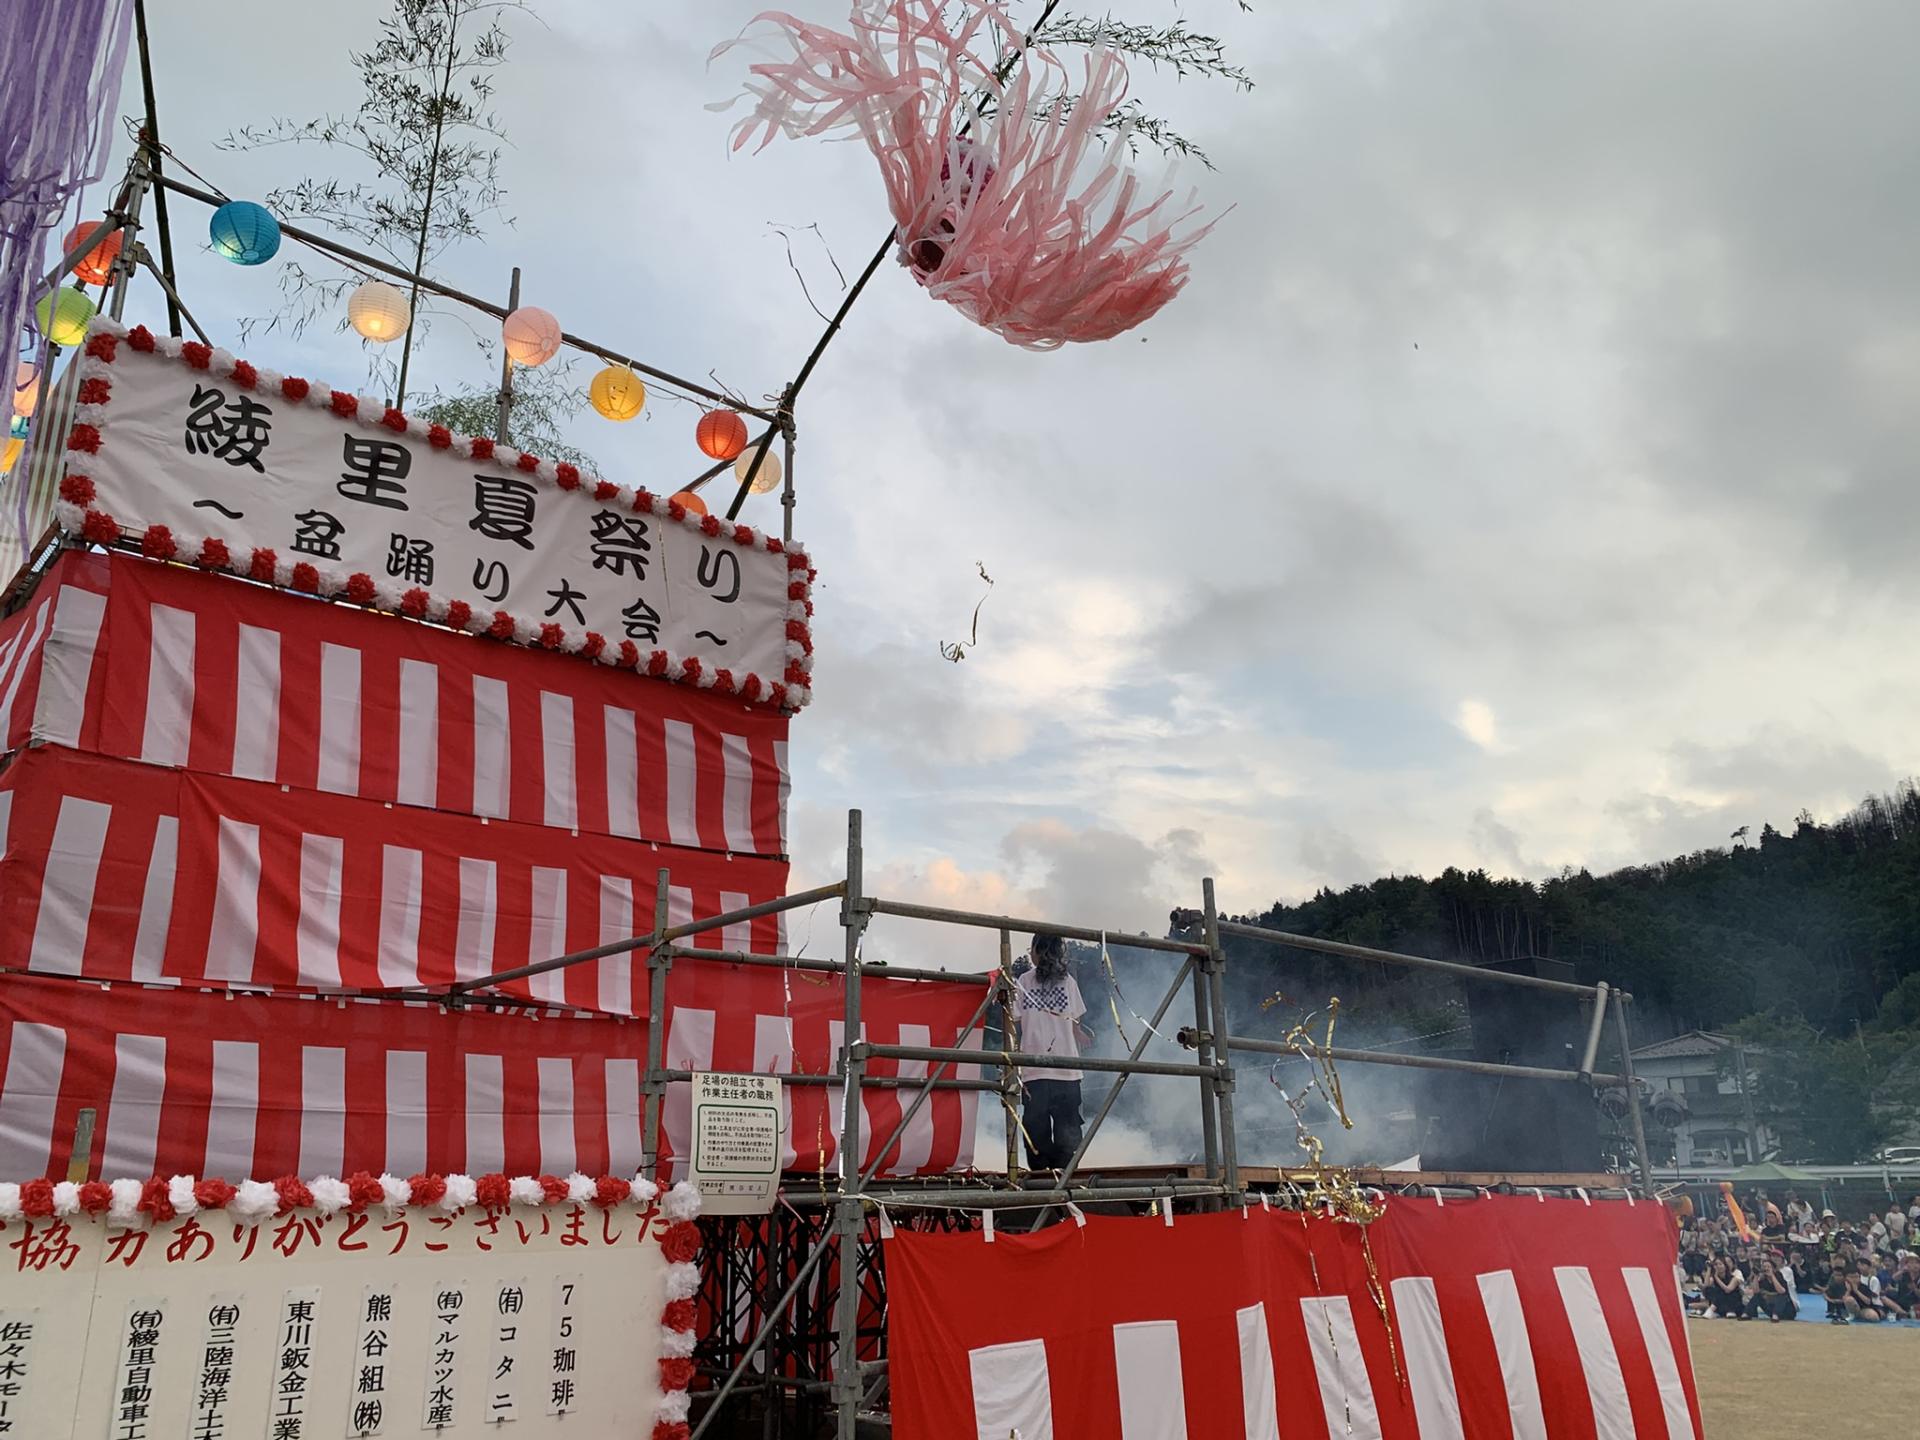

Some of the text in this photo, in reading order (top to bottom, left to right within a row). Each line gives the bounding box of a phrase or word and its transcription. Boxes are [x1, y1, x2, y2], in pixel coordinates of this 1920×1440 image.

[185, 384, 741, 603] 綾里夏祭り
[0, 1202, 670, 1272] 協力ありがとうございました
[552, 1284, 576, 1407] 75珈琲
